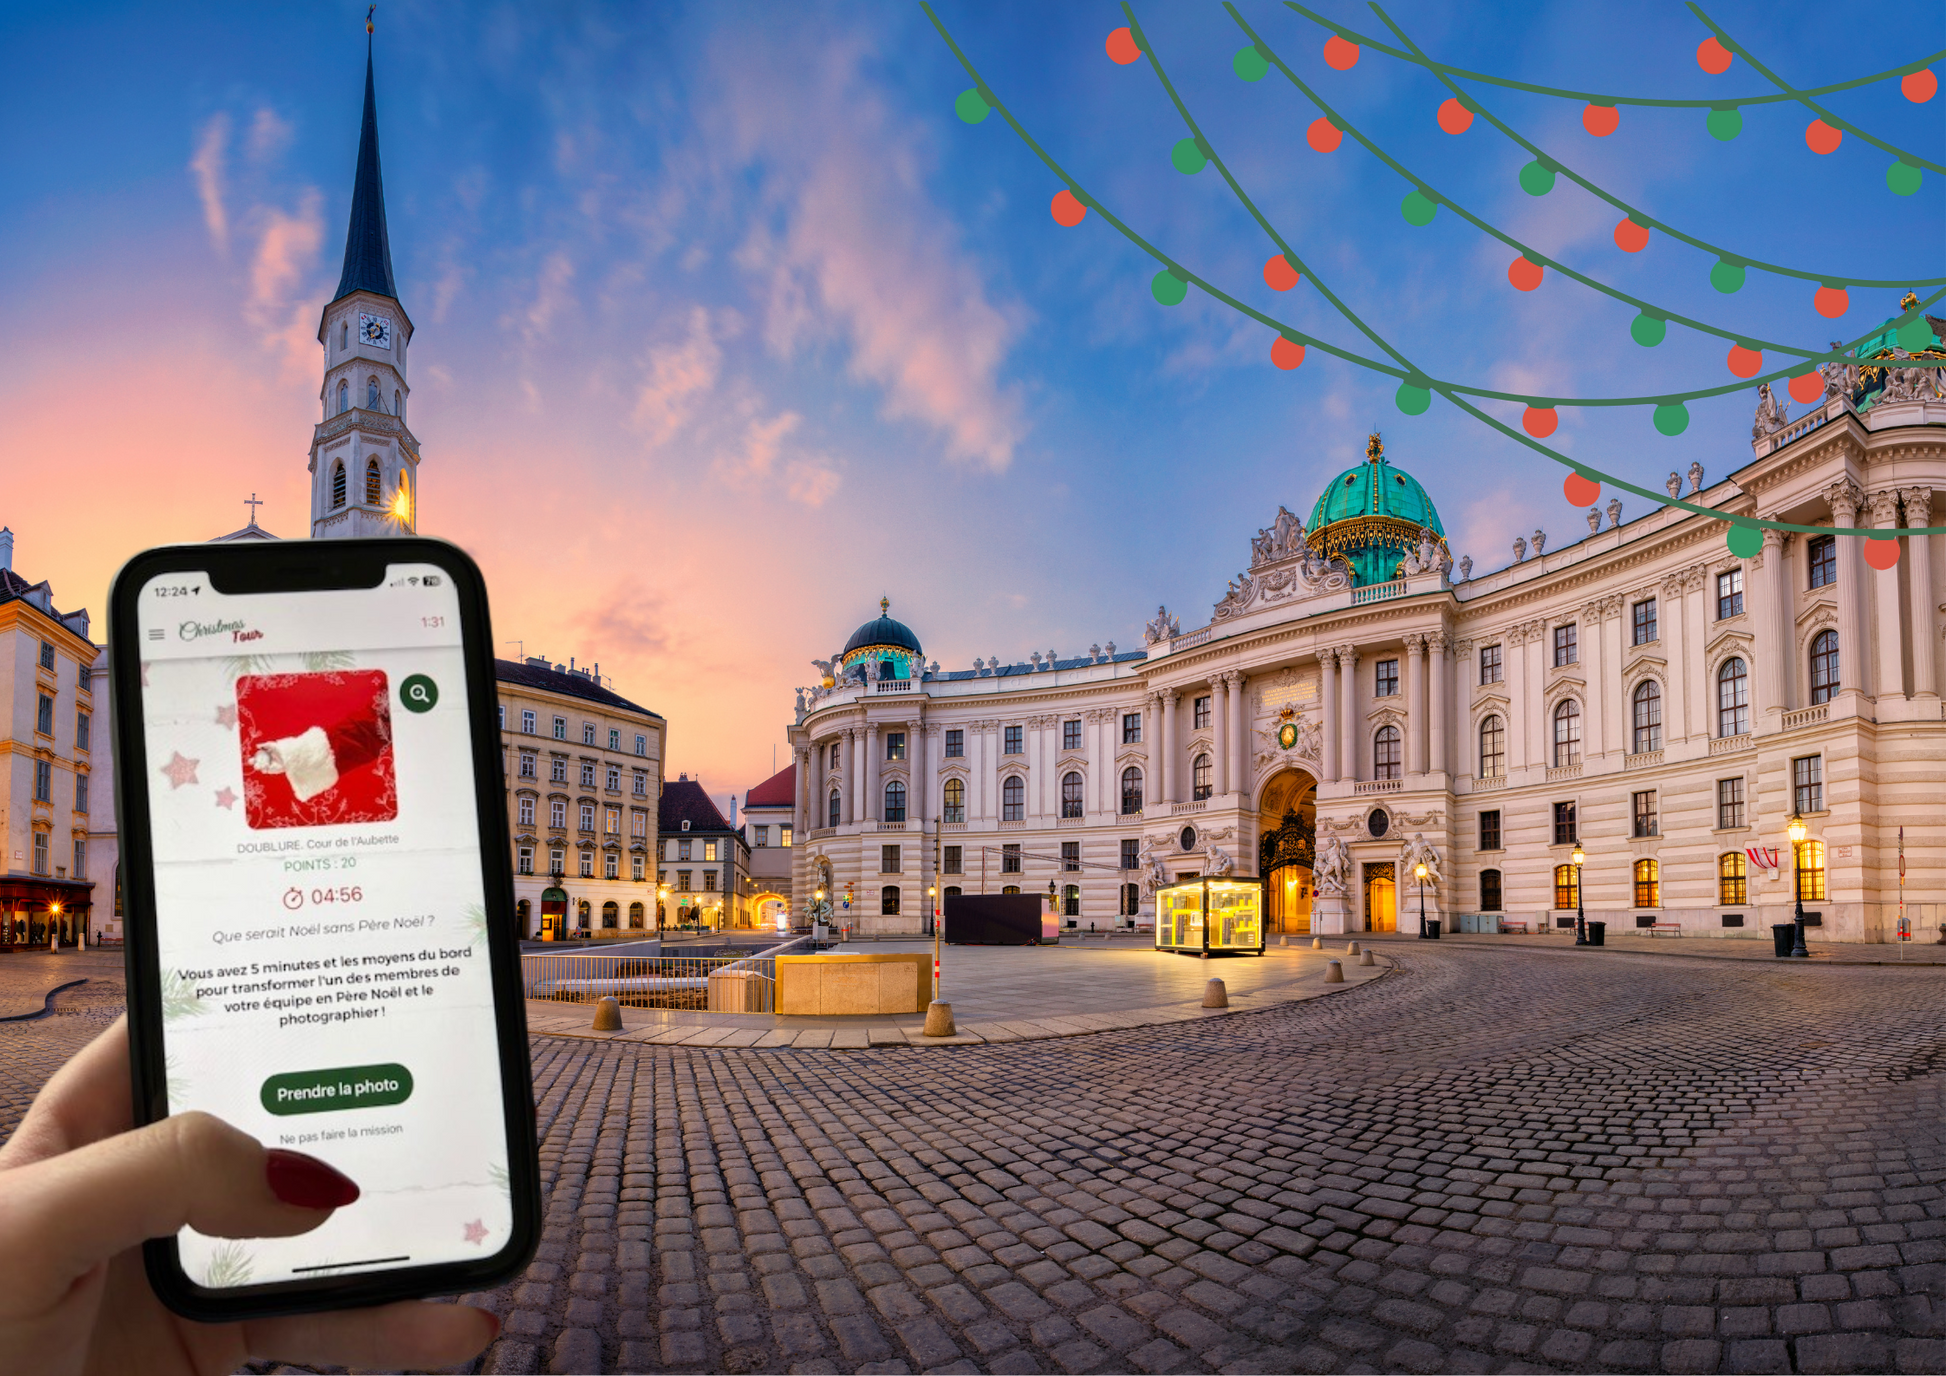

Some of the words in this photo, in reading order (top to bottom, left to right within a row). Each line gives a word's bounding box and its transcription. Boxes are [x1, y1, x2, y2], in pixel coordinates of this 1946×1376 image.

[155, 586, 187, 597] 12:24
[179, 620, 245, 642] Christmas
[421, 615, 445, 628] 1:31
[232, 629, 263, 643] Tour
[237, 840, 304, 853] DOUBLURE.
[307, 839, 332, 849] Cour
[335, 837, 349, 848] de
[351, 833, 399, 846] l'Aubette
[284, 859, 331, 872] POINTS
[341, 857, 356, 869] 20
[311, 886, 363, 904] 04:56
[212, 930, 242, 944] Que
[245, 926, 285, 940] serait
[289, 923, 321, 937] Noël
[323, 922, 355, 934] sans
[358, 919, 390, 931] Père
[393, 915, 424, 929] Noël
[427, 914, 435, 926] ?
[178, 969, 214, 980] Vous
[217, 966, 248, 978] avez
[251, 963, 259, 975] 5
[263, 960, 321, 973] minutes
[323, 957, 337, 969] et
[340, 955, 359, 967] les
[362, 952, 416, 966] moyens
[418, 949, 436, 961] du
[439, 946, 472, 959] bord
[196, 986, 229, 999] pour
[232, 979, 315, 994] transformer
[318, 974, 343, 987] l'un
[346, 972, 371, 985] des
[374, 967, 439, 982] membres
[441, 965, 460, 977] de
[224, 1000, 260, 1012] votre
[263, 994, 313, 1010] équipe
[316, 994, 333, 1004] en
[336, 990, 368, 1002] Père
[371, 986, 402, 1000] Noël
[405, 985, 419, 997] et
[421, 984, 434, 996] le
[279, 1007, 379, 1028] photographier
[381, 1006, 386, 1017] !
[277, 1084, 336, 1102] Prendre
[339, 1082, 352, 1096] la
[354, 1078, 399, 1097] photo
[280, 1134, 296, 1145] Ne
[299, 1132, 319, 1145] pas
[320, 1129, 346, 1141] faire
[348, 1127, 358, 1138] la
[360, 1123, 403, 1137] mission
